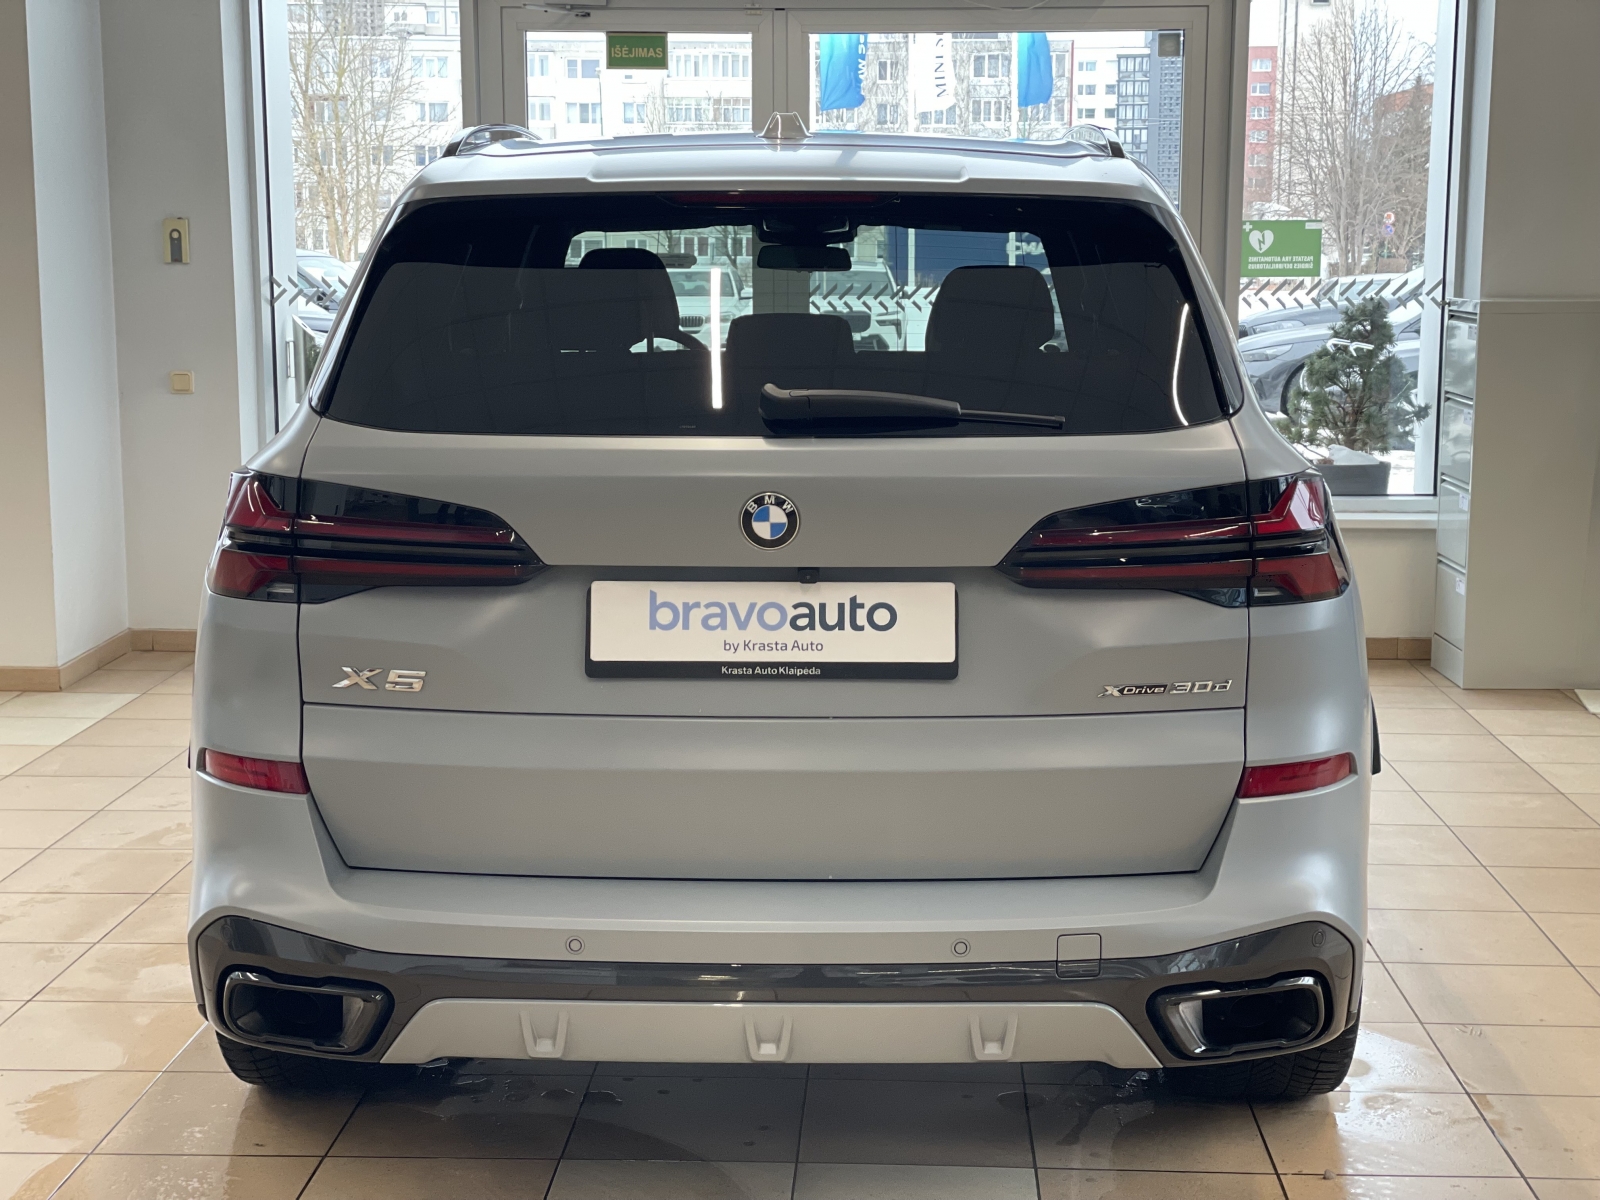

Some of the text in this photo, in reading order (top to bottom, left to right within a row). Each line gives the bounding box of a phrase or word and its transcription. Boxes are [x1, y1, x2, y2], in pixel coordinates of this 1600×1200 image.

[611, 44, 663, 58] IŠĖJIMAS
[746, 495, 794, 514] BMW
[649, 589, 898, 632] bravoauto
[723, 640, 824, 654] by Krasta Auto
[332, 666, 427, 692] X5
[721, 666, 821, 677] Krasta Auto Klaipėda
[1169, 679, 1233, 695] 30d
